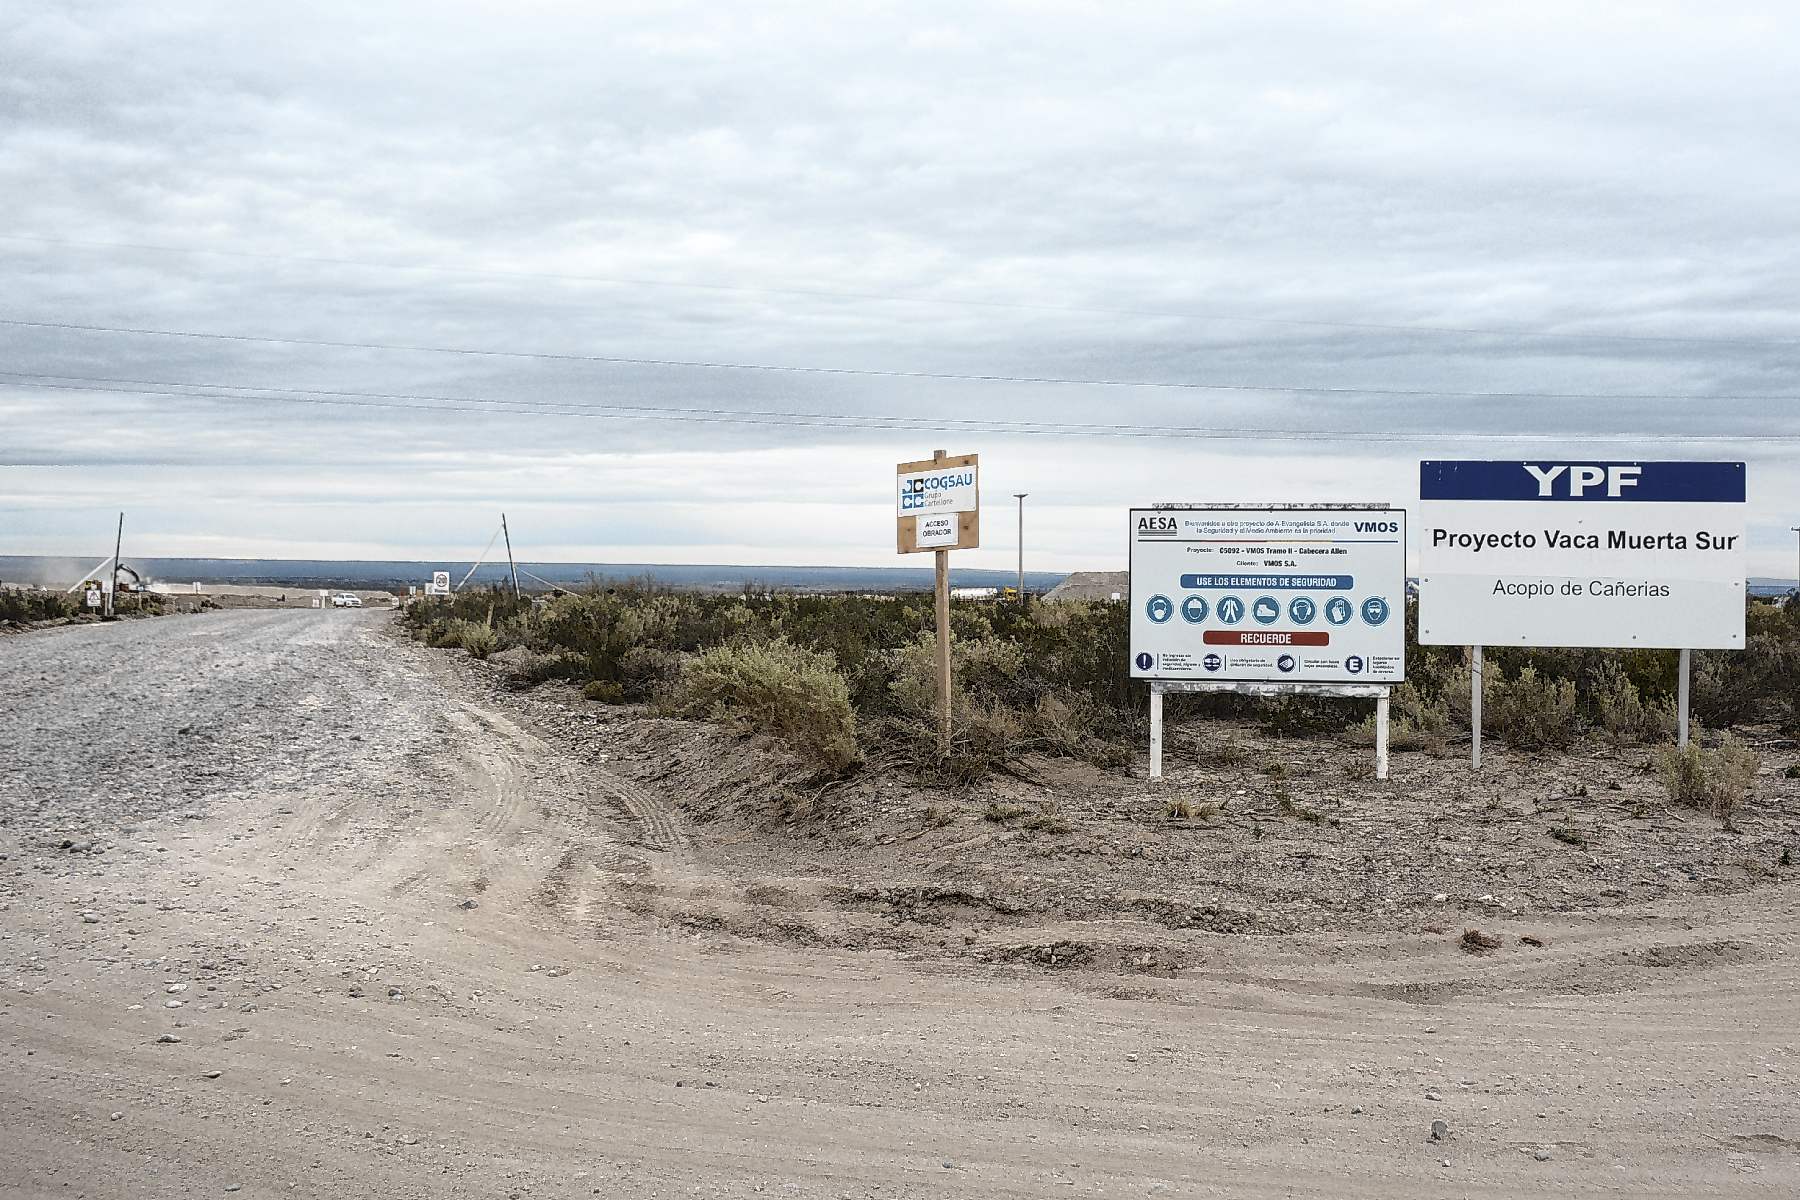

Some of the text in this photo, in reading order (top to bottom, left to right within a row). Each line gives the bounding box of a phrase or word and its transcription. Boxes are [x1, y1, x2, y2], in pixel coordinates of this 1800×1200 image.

[924, 474, 973, 490] COGSAU
[1523, 465, 1642, 497] YPF
[924, 492, 942, 500] Grupo
[925, 519, 949, 527] ACCESO
[1138, 517, 1178, 530] AESA
[1354, 522, 1399, 533] VMOS
[923, 528, 952, 537] OBRADOR
[1432, 528, 1737, 552] Proyecto Vaca Muerta Sur
[1196, 576, 1337, 587] USE LOS ELEMENTOS DE SEGURIDAD
[1492, 579, 1670, 599] Acopio de Cañerias
[1240, 632, 1292, 644] RECUERDE
